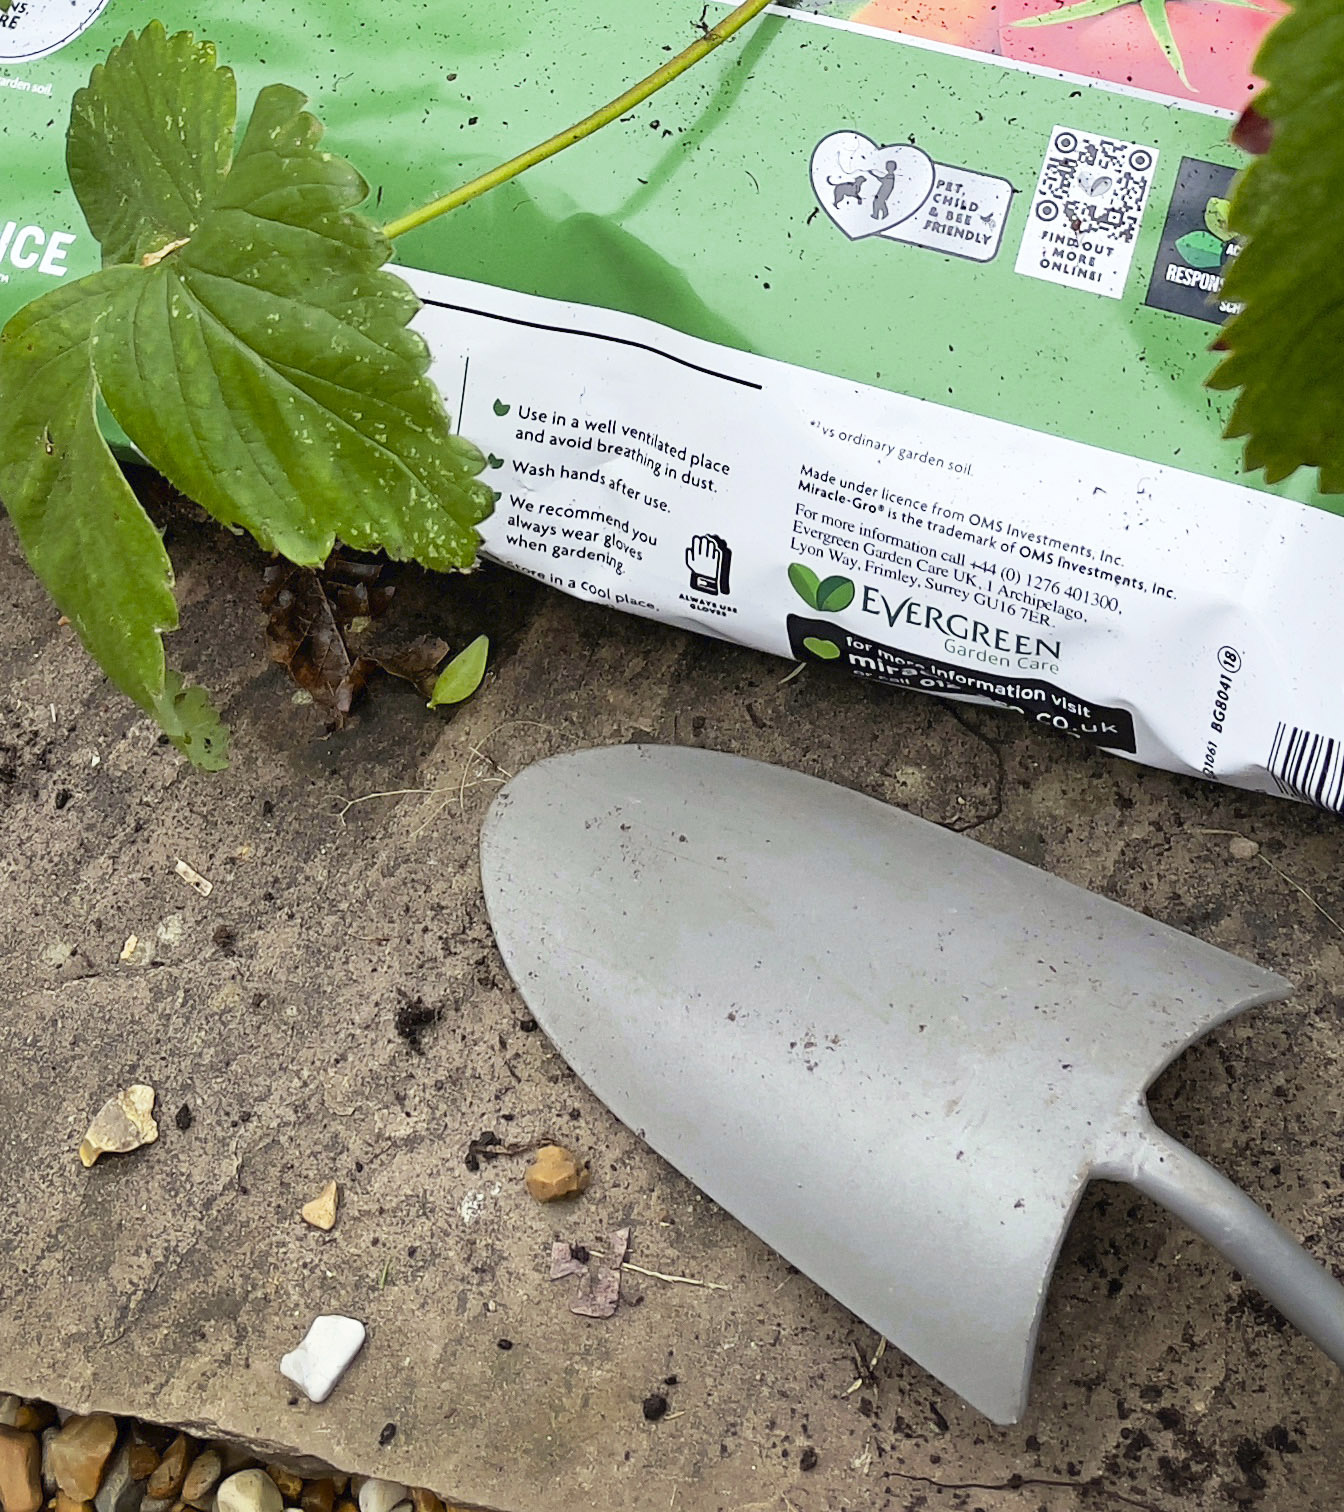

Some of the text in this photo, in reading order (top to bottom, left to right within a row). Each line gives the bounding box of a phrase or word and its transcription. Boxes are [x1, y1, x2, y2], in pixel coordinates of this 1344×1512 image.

[933, 193, 979, 212] CHILD
[946, 210, 972, 225] BEE
[923, 219, 992, 245] FRIENDLY
[1041, 230, 1115, 257] FIND OUT
[1039, 259, 1103, 282] ONLINE!
[1052, 246, 1095, 266] MORE
[515, 429, 717, 493] and avoid breathing in dust.
[517, 405, 730, 476] Use in a well ventilated place
[838, 431, 895, 456] ordinary
[897, 448, 944, 468] garden
[948, 461, 974, 477] soil.
[512, 459, 671, 514] Wash hands after use.
[507, 515, 644, 562] always wear gloves
[509, 494, 658, 547] We recommend you
[800, 464, 1125, 567] Made under licence from OMS Investments, Inc.
[506, 534, 626, 576] when gardening.
[793, 519, 859, 552] Evergreen
[863, 542, 912, 568] Garden
[916, 559, 949, 577] Care
[997, 585, 1087, 623] Archipelago,
[795, 502, 1122, 615] For more information call +44 (0) 1276 401300,
[887, 508, 898, 520] is
[901, 512, 924, 528] the
[927, 519, 997, 549] trademark
[1000, 541, 1016, 554] of
[1019, 546, 1054, 565] OMS
[1057, 556, 1148, 594] Investments,
[1152, 582, 1177, 600] Inc.
[550, 573, 563, 586] in
[568, 579, 576, 589] a
[580, 581, 611, 600] cool
[615, 593, 660, 612] place.
[679, 593, 737, 613] ALWAYS USE
[790, 536, 1055, 628] Lyon Way, Frimley, Surrey GU16 7ER.
[690, 603, 727, 617] GLOVES
[862, 585, 1061, 660] EVERGREEN
[846, 636, 873, 652] for
[931, 664, 1047, 703] information
[1051, 691, 1092, 719] visit
[944, 638, 1010, 669] Garden
[1017, 657, 1060, 675] Care
[1211, 674, 1232, 733] BG8041
[1223, 651, 1237, 668] 18
